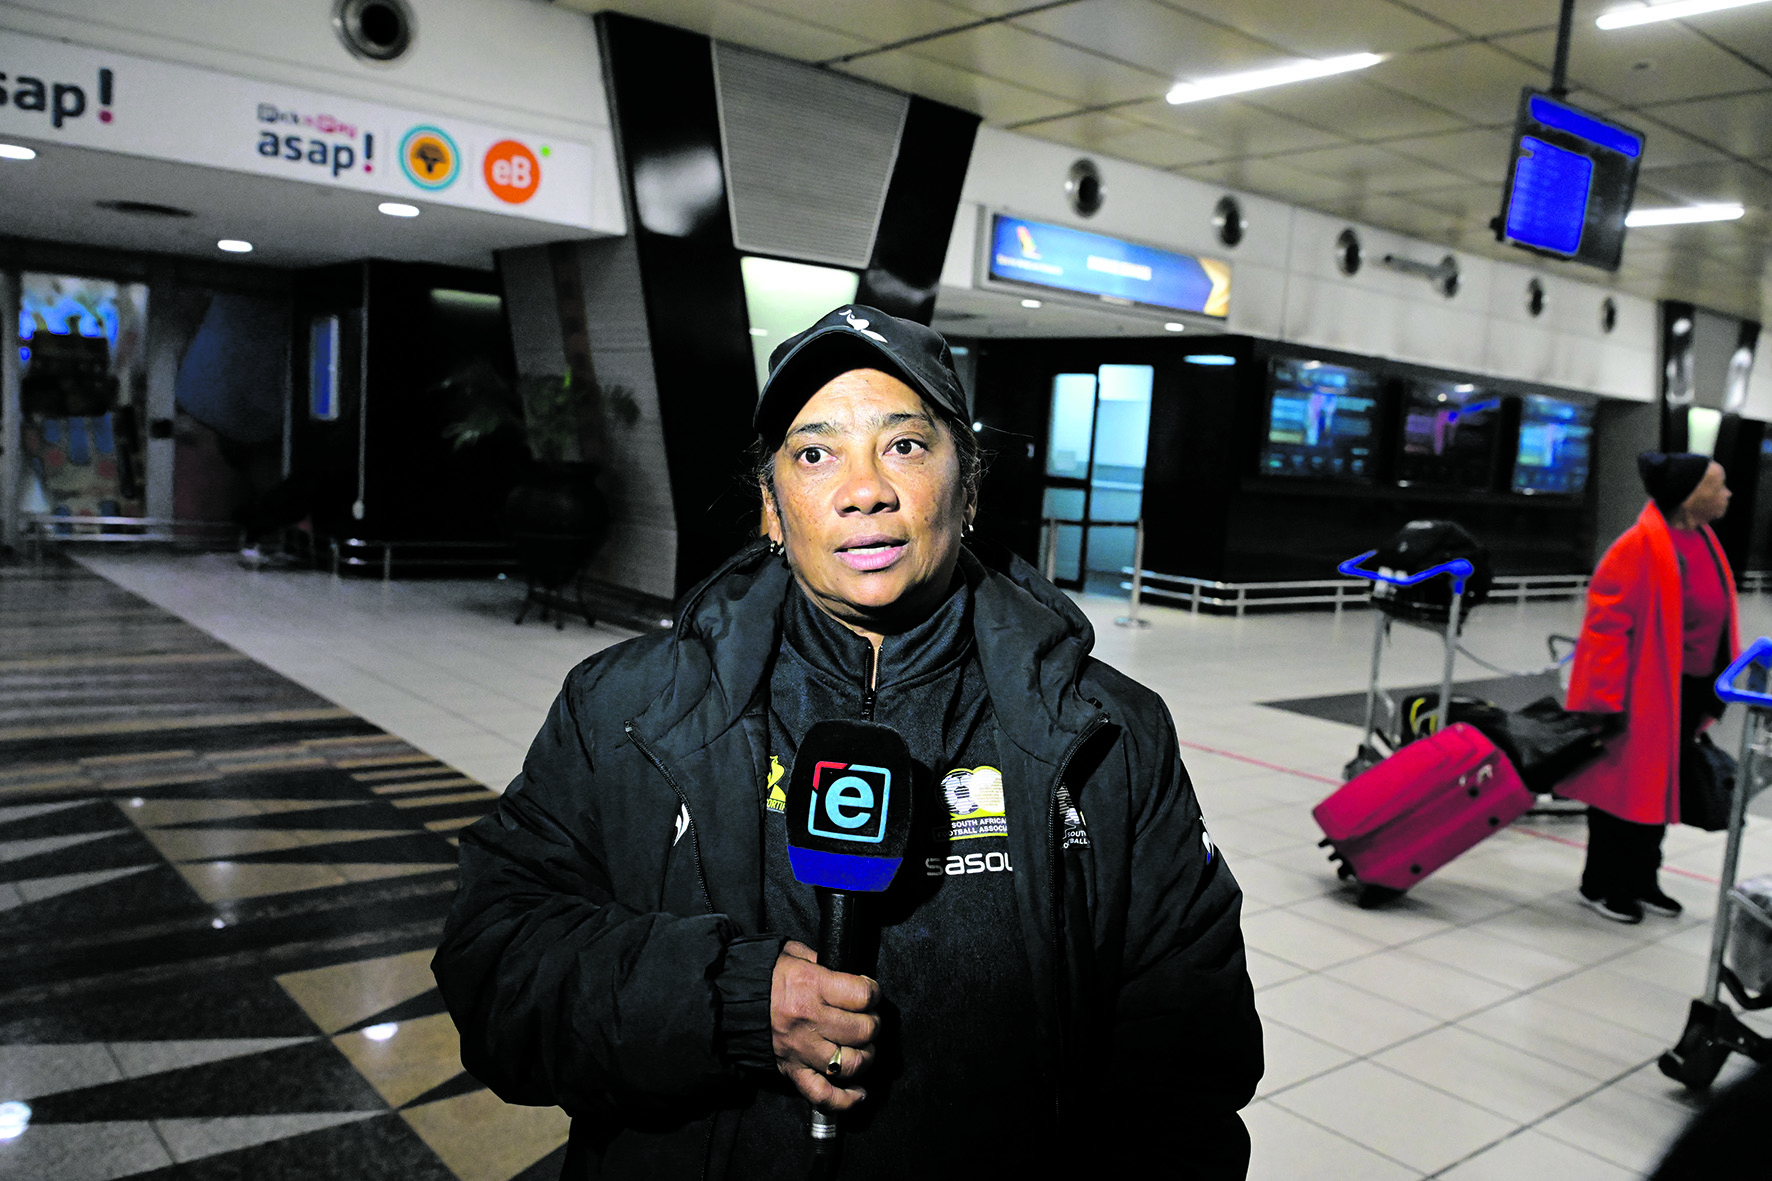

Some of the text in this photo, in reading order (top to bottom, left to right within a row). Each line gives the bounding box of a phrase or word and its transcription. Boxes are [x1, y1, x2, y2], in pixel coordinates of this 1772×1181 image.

[258, 130, 372, 176] asap!
[492, 154, 532, 189] eB
[767, 798, 785, 811] ORTI
[825, 776, 874, 828] e
[951, 817, 1007, 829] SOUTH AFRICA
